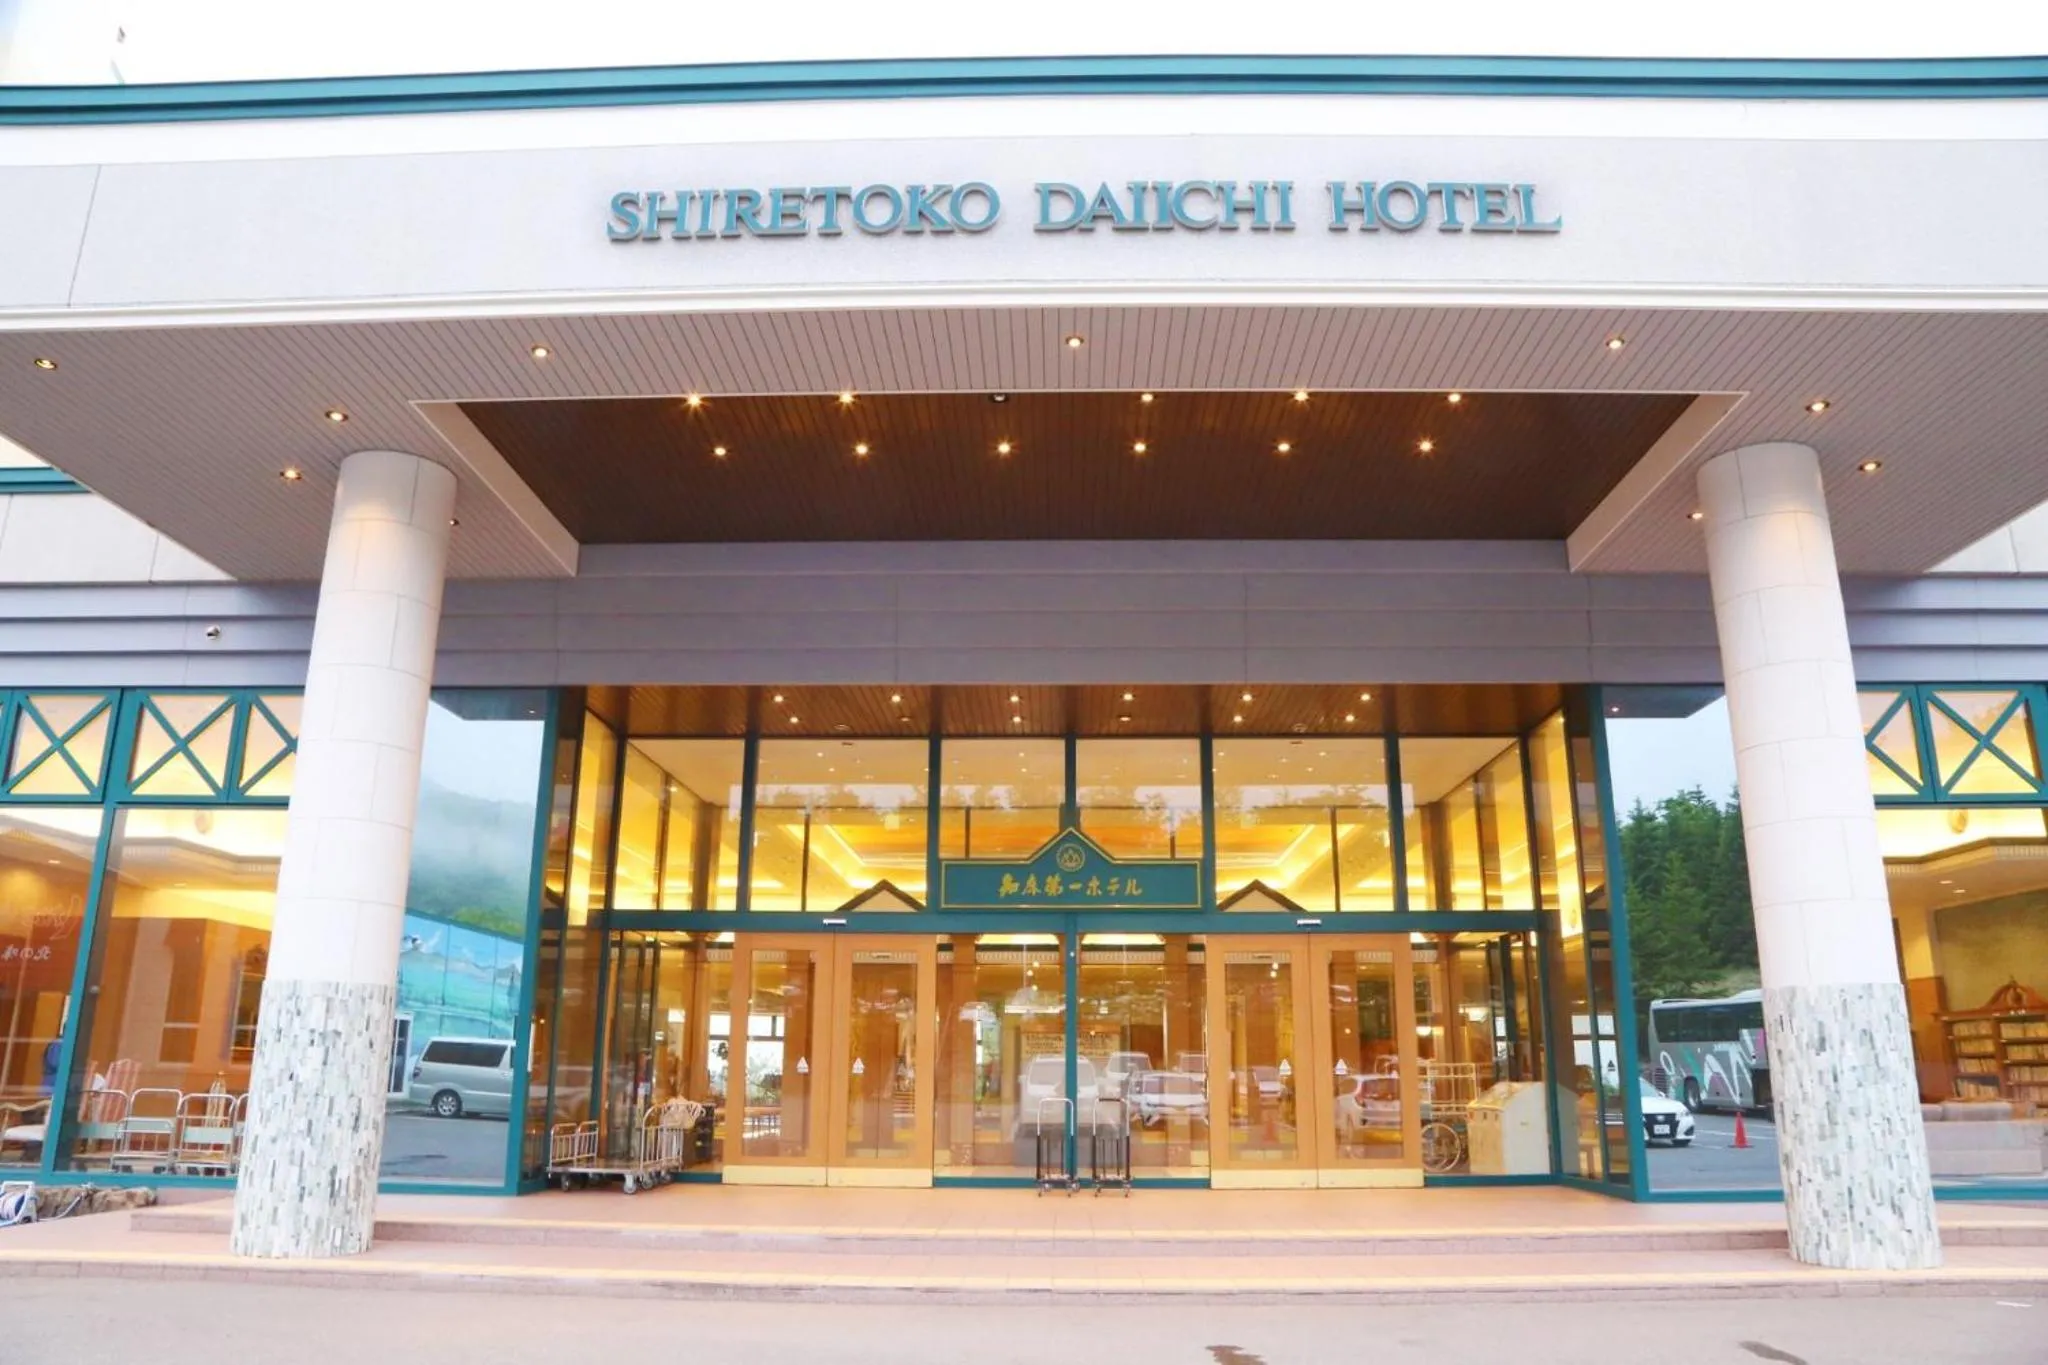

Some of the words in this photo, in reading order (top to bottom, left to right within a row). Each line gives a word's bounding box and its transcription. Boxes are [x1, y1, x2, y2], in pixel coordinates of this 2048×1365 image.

[606, 181, 1001, 241] SHIRETOKO
[1033, 179, 1298, 233] DAIICHI
[1325, 179, 1564, 234] HOTEL
